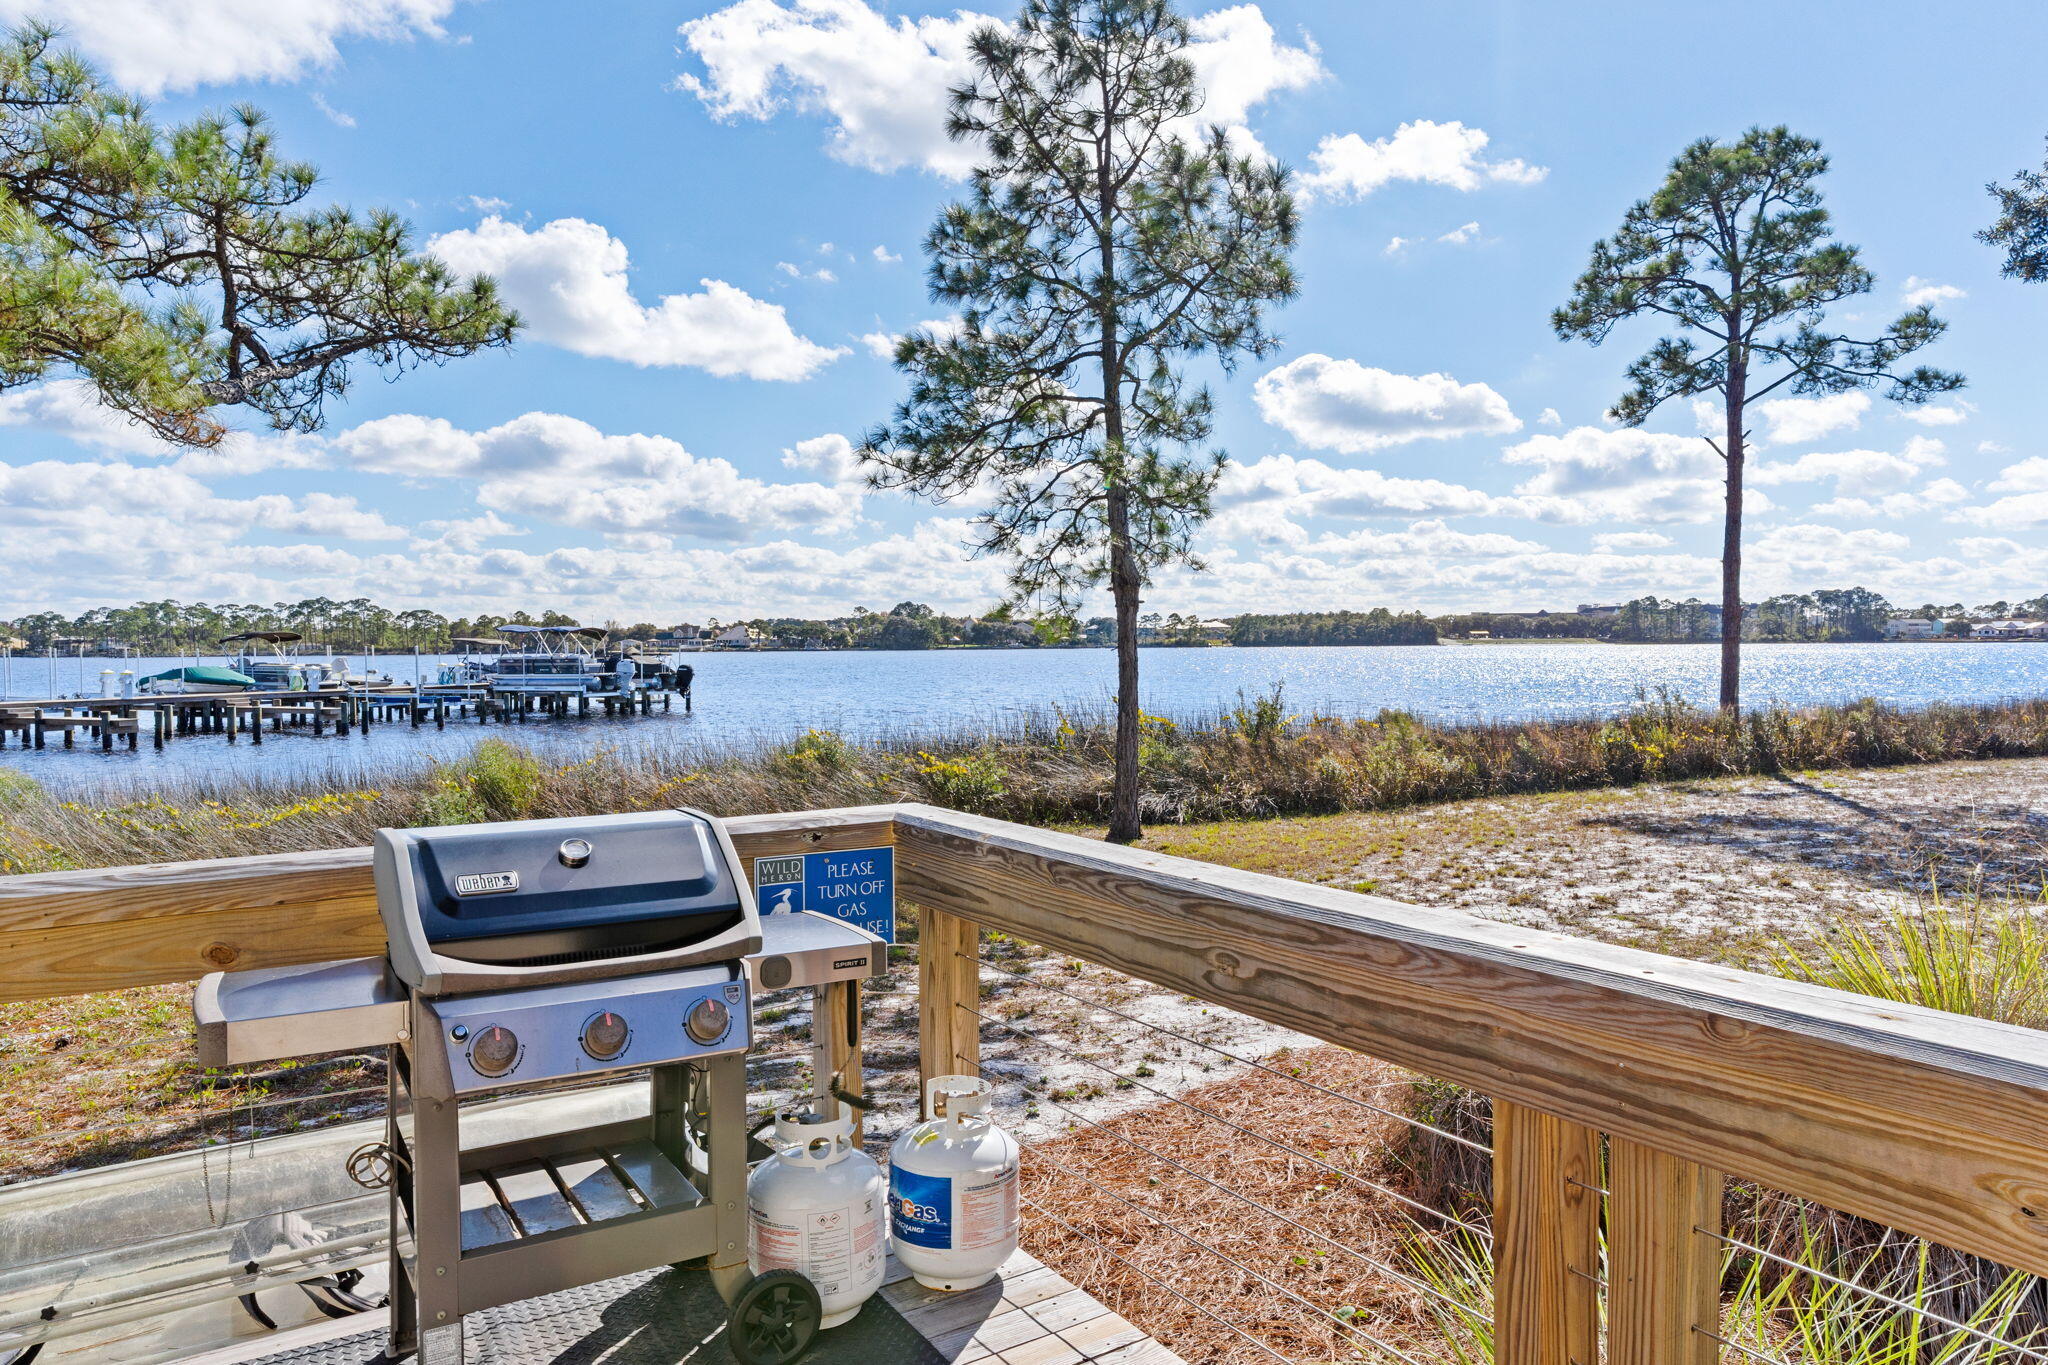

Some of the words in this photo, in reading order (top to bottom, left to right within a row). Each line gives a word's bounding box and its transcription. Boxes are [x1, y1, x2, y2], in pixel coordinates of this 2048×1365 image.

[761, 860, 801, 874] WILD
[827, 861, 875, 878] PLEASE
[461, 875, 500, 890] weber
[761, 873, 801, 883] HERON
[817, 883, 857, 899] TURN
[860, 879, 885, 895] OFF
[837, 901, 867, 918] GAS
